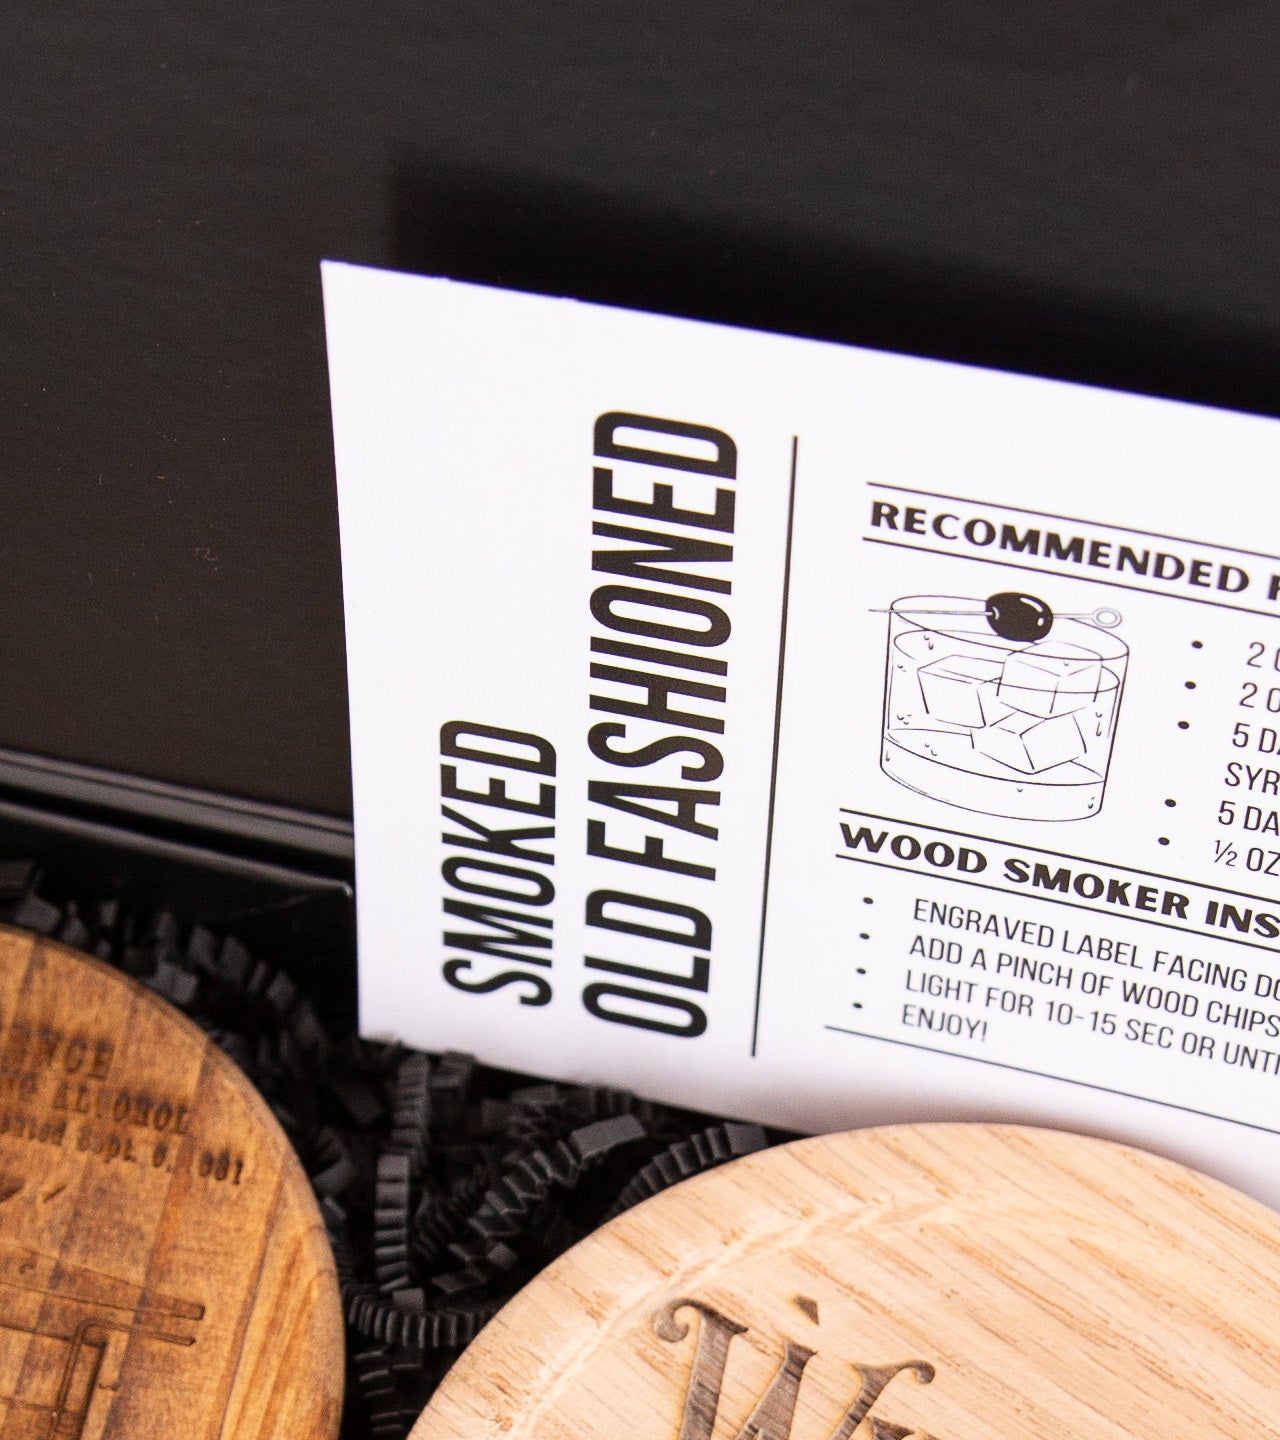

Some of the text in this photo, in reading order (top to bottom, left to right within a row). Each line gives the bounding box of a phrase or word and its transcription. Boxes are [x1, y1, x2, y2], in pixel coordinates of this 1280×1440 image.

[870, 500, 1250, 593] RECOMMENDED
[1238, 681, 1258, 709] 2
[1246, 641, 1266, 669] 2
[583, 411, 738, 1039] OLD FASHIONED
[1232, 722, 1251, 748] 5
[1217, 799, 1236, 826] 5
[439, 720, 557, 1007] SMOKED
[838, 822, 988, 874] WOOD
[1003, 858, 1190, 920] SMOKER
[909, 934, 963, 965] ADD
[970, 947, 987, 971] A
[996, 952, 1073, 990] PINCH
[1080, 971, 1114, 997] OF
[1122, 979, 1199, 1018] WOOD
[913, 898, 1055, 949] ENGRAVED
[1061, 929, 1143, 970] LABEL
[1152, 950, 1248, 992] FACING
[902, 1004, 988, 1039] ENJOY!
[905, 969, 978, 1003] LIGHT
[985, 986, 1034, 1017] FOR
[1047, 1000, 1116, 1036] 10-15
[1124, 1018, 1174, 1049] SEC
[1181, 1031, 1216, 1060] OR
